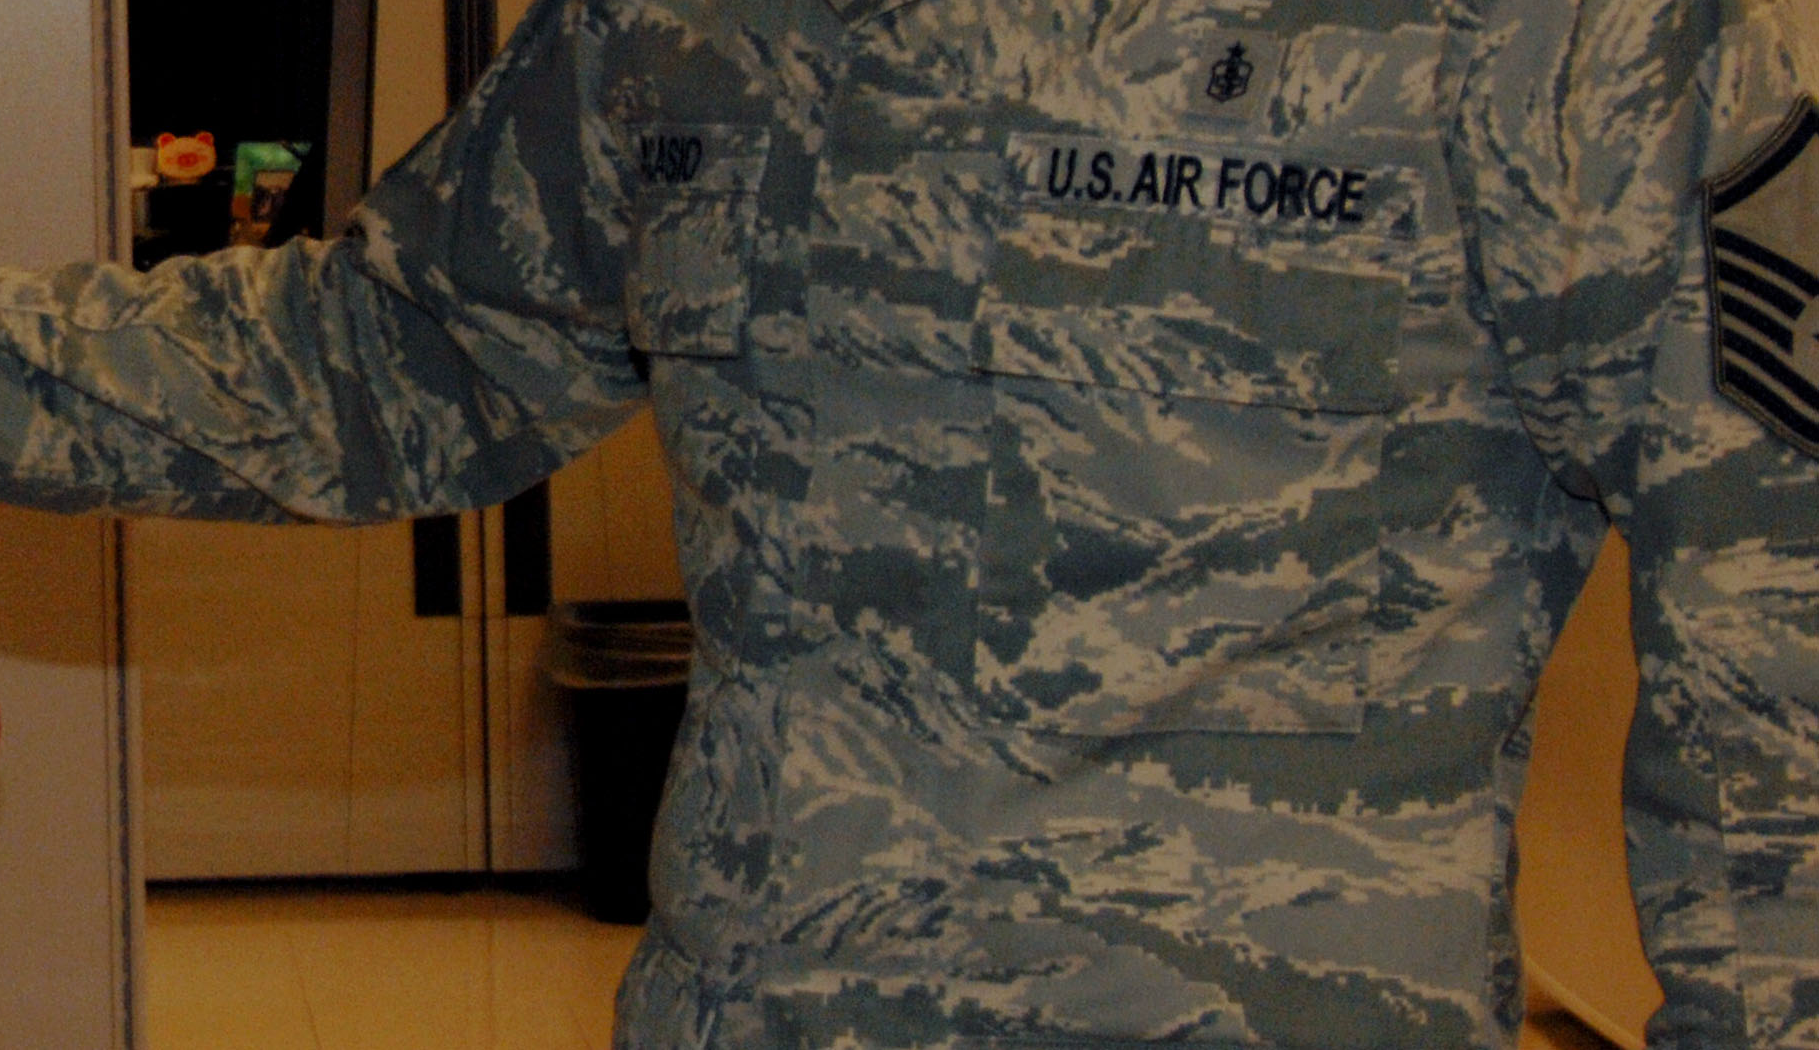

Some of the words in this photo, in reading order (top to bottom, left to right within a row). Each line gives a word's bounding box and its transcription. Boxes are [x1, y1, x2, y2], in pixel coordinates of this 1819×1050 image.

[1048, 148, 1122, 201] U.S.
[1128, 151, 1203, 208] AIR
[1217, 158, 1368, 222] FORCE
